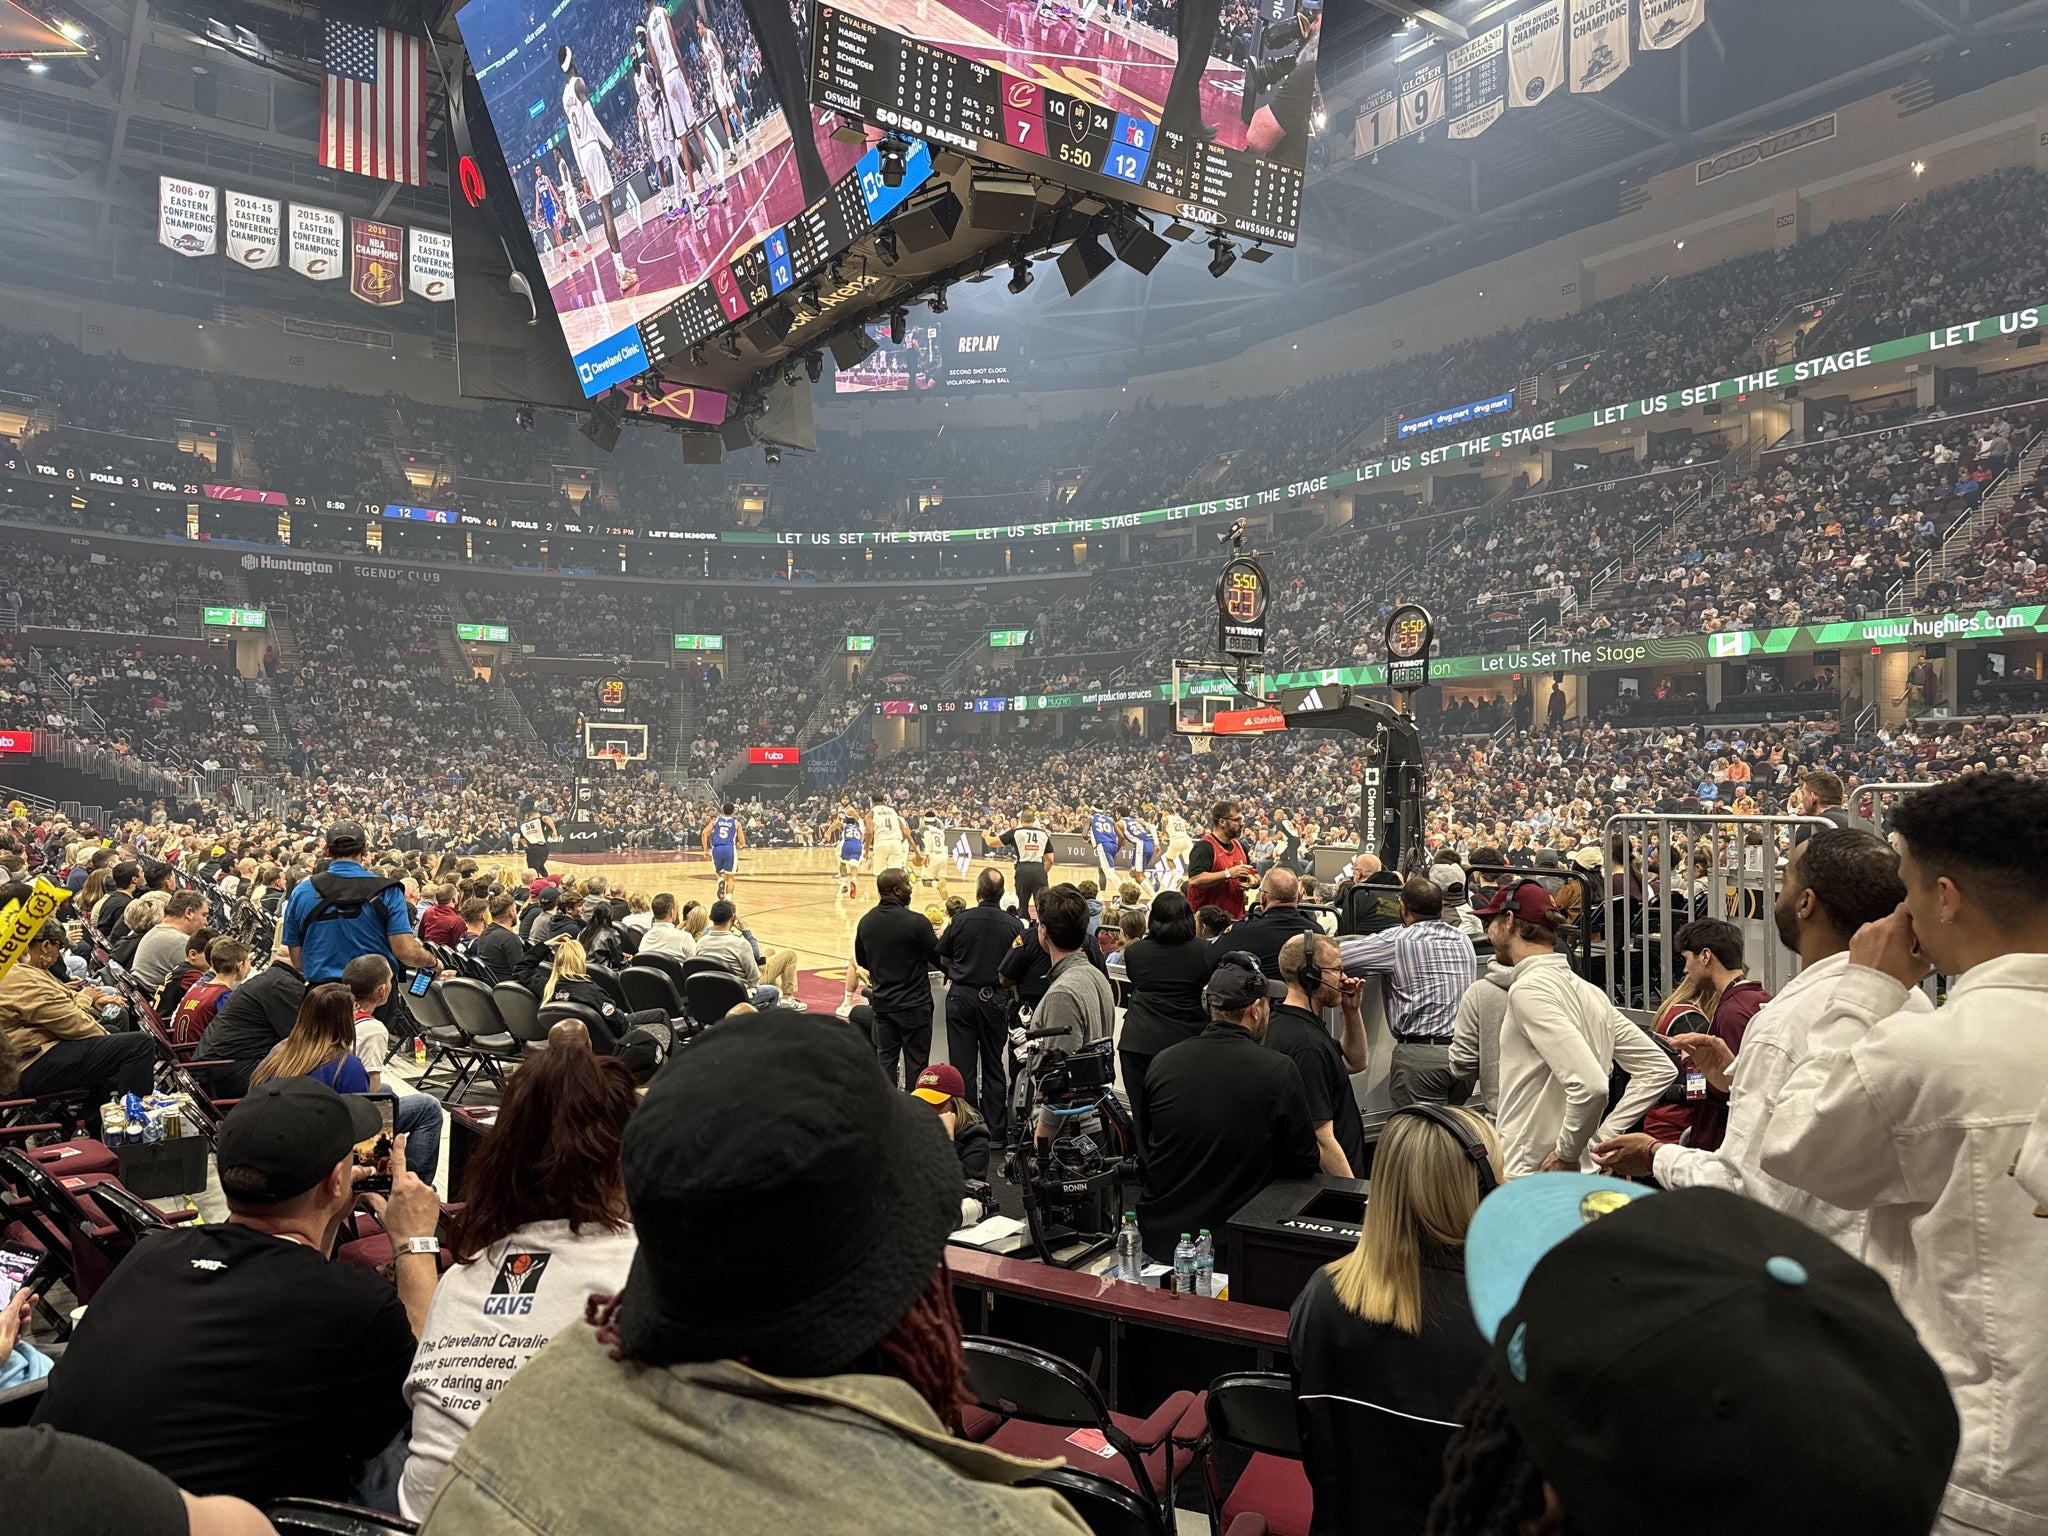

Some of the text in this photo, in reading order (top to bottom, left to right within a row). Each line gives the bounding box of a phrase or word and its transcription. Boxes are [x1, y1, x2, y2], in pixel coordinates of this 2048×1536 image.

[839, 14, 877, 34] CAVALIERS
[1515, 7, 1558, 34] NORTH DIVISION
[1574, 4, 1627, 39] CHAMPIONS
[839, 28, 867, 43] HARDEN
[1512, 14, 1560, 45] CHAMPIONS
[837, 40, 865, 55] MOBLEY
[1449, 30, 1502, 62] CLEVELAND
[836, 51, 874, 71] SCHRODER
[1457, 43, 1493, 67] BARONS
[836, 64, 853, 76] ELLIS
[970, 64, 990, 76] FOULS
[819, 70, 858, 90] 20 TYSON
[1402, 66, 1441, 92] GLOVER
[825, 90, 862, 111] oswald
[1049, 100, 1065, 116] 1Q
[1360, 91, 1392, 113] BOWER
[1415, 90, 1428, 125] 9
[986, 105, 994, 114] 25
[1094, 115, 1108, 130] 24
[1456, 115, 1481, 130] CALDER
[1457, 115, 1495, 136] CHAMPIONS
[926, 125, 978, 151] RAFFLE
[1017, 121, 1030, 143] 7
[1166, 130, 1183, 142] FOULS
[1059, 144, 1092, 167] 5:50
[1207, 156, 1227, 166] GRIMES
[1116, 154, 1136, 179] 12
[1206, 166, 1232, 178] WATFORD
[1205, 176, 1223, 187] PAYNE
[170, 184, 209, 199] 2006-07
[1203, 186, 1227, 197] BARLOW
[171, 197, 208, 211] EASTERN
[235, 198, 272, 213] 2014-15
[164, 206, 215, 223] CONFERENCE
[236, 211, 271, 224] EASTERN
[298, 210, 335, 224] 2015-16
[1182, 204, 1217, 224] $3,004
[1778, 215, 1793, 226] 209
[166, 217, 212, 234] CHAMPIONS
[230, 219, 278, 236] CONFERENCE
[299, 222, 333, 235] EASTERN
[368, 225, 386, 235] 2016
[1235, 219, 1295, 242] CAVS5050.COM
[232, 230, 275, 246] CHAMPIONS
[293, 231, 340, 247] CONFERENCE
[370, 238, 385, 250] NBA
[418, 234, 450, 247] 2016-17
[295, 242, 338, 257] CHAMPIONS
[356, 244, 398, 261] CHAMPIONS
[419, 246, 449, 258] EASTERN
[415, 265, 453, 279] CHAMPIONS
[775, 267, 788, 285] 12
[751, 287, 768, 305] 5:50
[1930, 308, 2038, 350] LET US
[959, 335, 1000, 352] REPLAY
[592, 343, 640, 374] Cleveland Clinic
[1593, 346, 1871, 427] LET US SET THE STAGE
[1474, 398, 1508, 413] drug mart
[1437, 408, 1469, 424] drug mart
[1402, 418, 1433, 433] drug mart
[1356, 421, 1556, 481] LET US SET THE STAGE
[37, 465, 197, 494] TOL 6 FOULS FG% 25
[1603, 483, 1615, 491] 107
[1167, 476, 1328, 520] LET US SET THE STAGE
[295, 498, 411, 517] 23 5:50 1Q 12
[462, 516, 481, 524] FG%
[486, 519, 497, 527] 44
[512, 521, 538, 529] FOULS
[565, 524, 581, 532] TOL
[606, 527, 621, 535] 7:25
[975, 513, 1141, 540] LET US SET THE STAGE
[776, 530, 951, 544] LET US SET THE STAGE
[261, 555, 332, 575] Huntington
[1233, 574, 1257, 589] 5:50
[1229, 589, 1254, 616] 23
[1236, 626, 1263, 637] TISSOT
[1863, 613, 2024, 639] www.hughies.com
[1399, 659, 1424, 667] TISSOT
[1482, 646, 1646, 671] Let Us Set The Stage
[607, 682, 622, 690] 5:50
[604, 689, 621, 703] 23
[1082, 689, 1152, 703] event production services
[937, 702, 955, 712] 5:50
[846, 741, 854, 749] Full
[764, 751, 784, 760] fubo
[850, 751, 865, 760] Power
[1367, 788, 1376, 840] Cleveland
[885, 818, 892, 830] 4
[1095, 822, 1111, 833] 30
[719, 827, 729, 838] 5
[1027, 833, 1038, 843] 74
[1068, 847, 1085, 856] YOU
[1063, 1183, 1088, 1192] RONIN
[1284, 1221, 1333, 1232] ONLY
[483, 1296, 534, 1315] CAVS
[438, 1334, 497, 1349] Cleveland
[438, 1355, 517, 1370] surrendered.
[441, 1375, 483, 1392] daring
[442, 1395, 480, 1410] since
